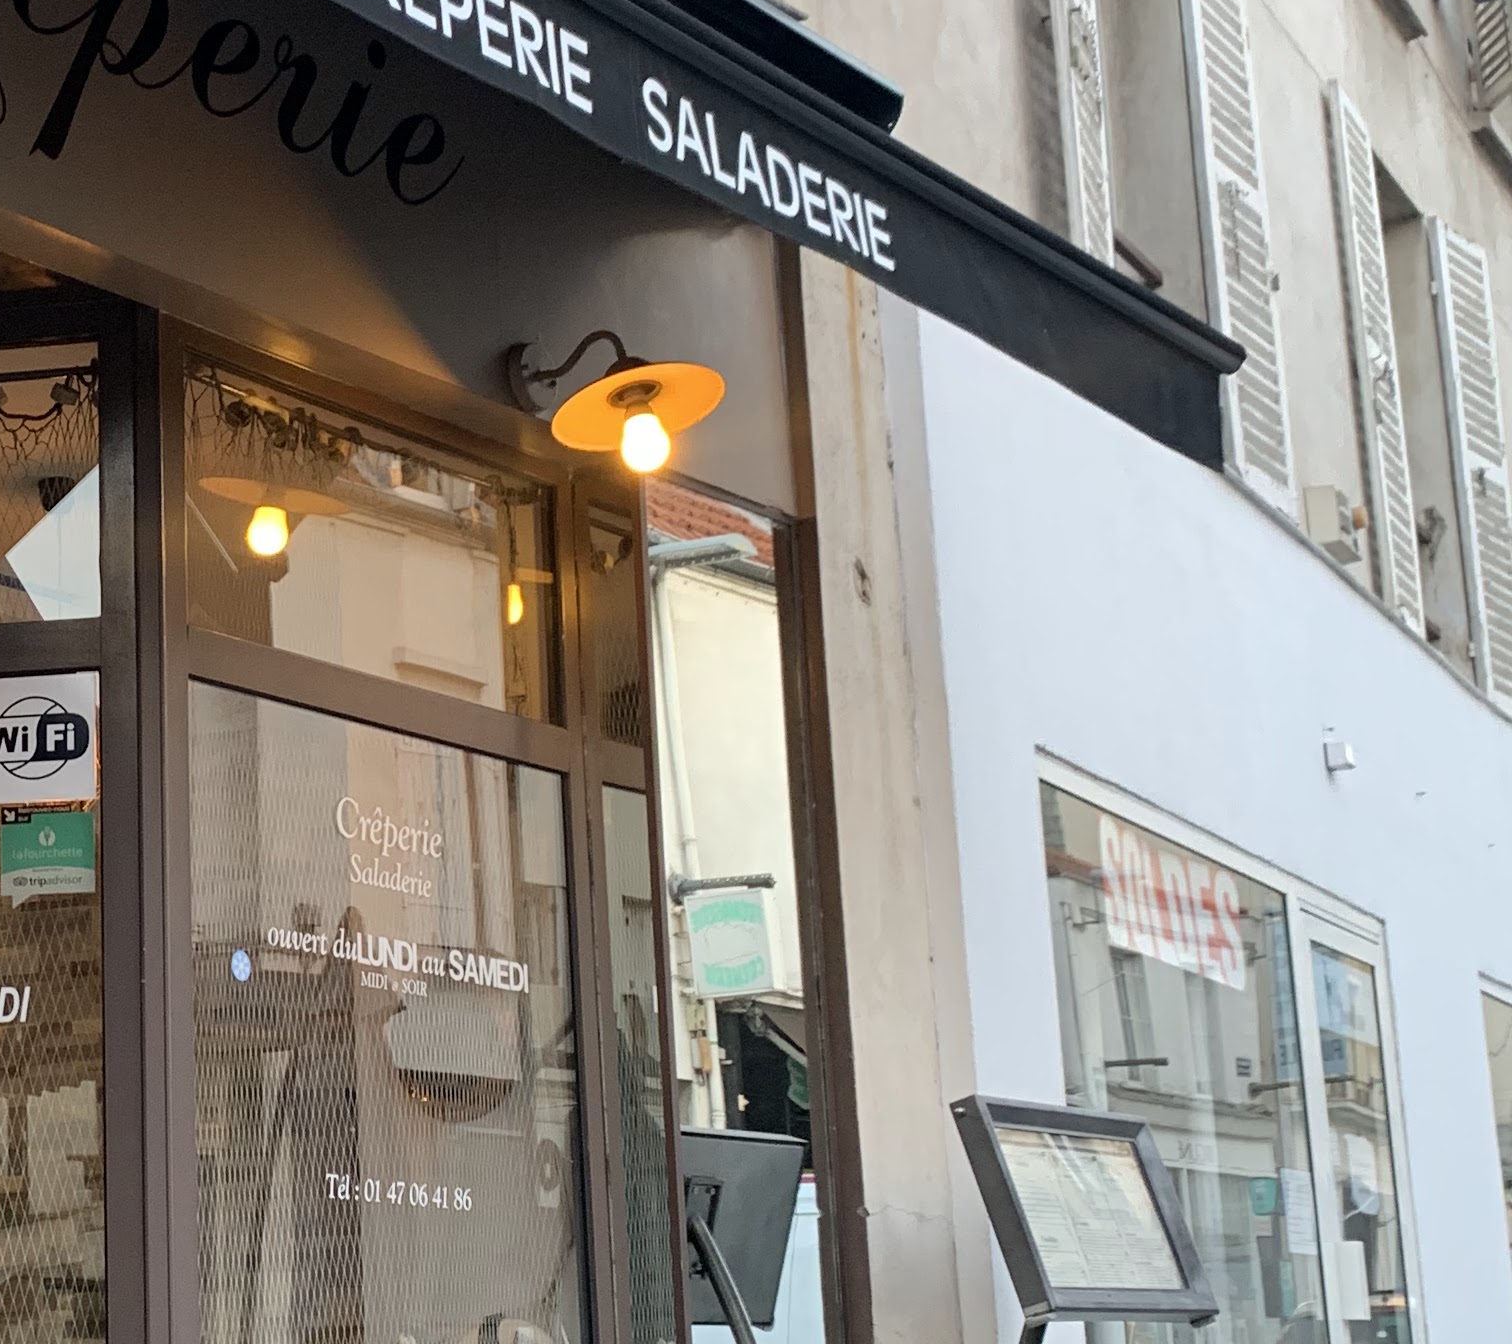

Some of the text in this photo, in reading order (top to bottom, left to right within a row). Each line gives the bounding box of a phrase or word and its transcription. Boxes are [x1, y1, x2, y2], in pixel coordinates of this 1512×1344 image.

[641, 77, 896, 272] SALADERIE
[336, 796, 444, 859] Crêperie
[29, 876, 83, 888] tripadvisor
[349, 854, 433, 899] Saladerie
[1099, 811, 1245, 991] SOLDES
[267, 926, 328, 956] ouvert
[356, 931, 419, 975] LUNDI
[421, 956, 446, 978] au
[448, 950, 530, 994] SAMEDI
[360, 970, 388, 991] MIDI
[401, 977, 428, 997] SOIR
[364, 1180, 381, 1203] 01
[387, 1181, 405, 1205] 47
[410, 1183, 428, 1207] 06
[432, 1184, 449, 1208] 41
[454, 1187, 472, 1211] 86
